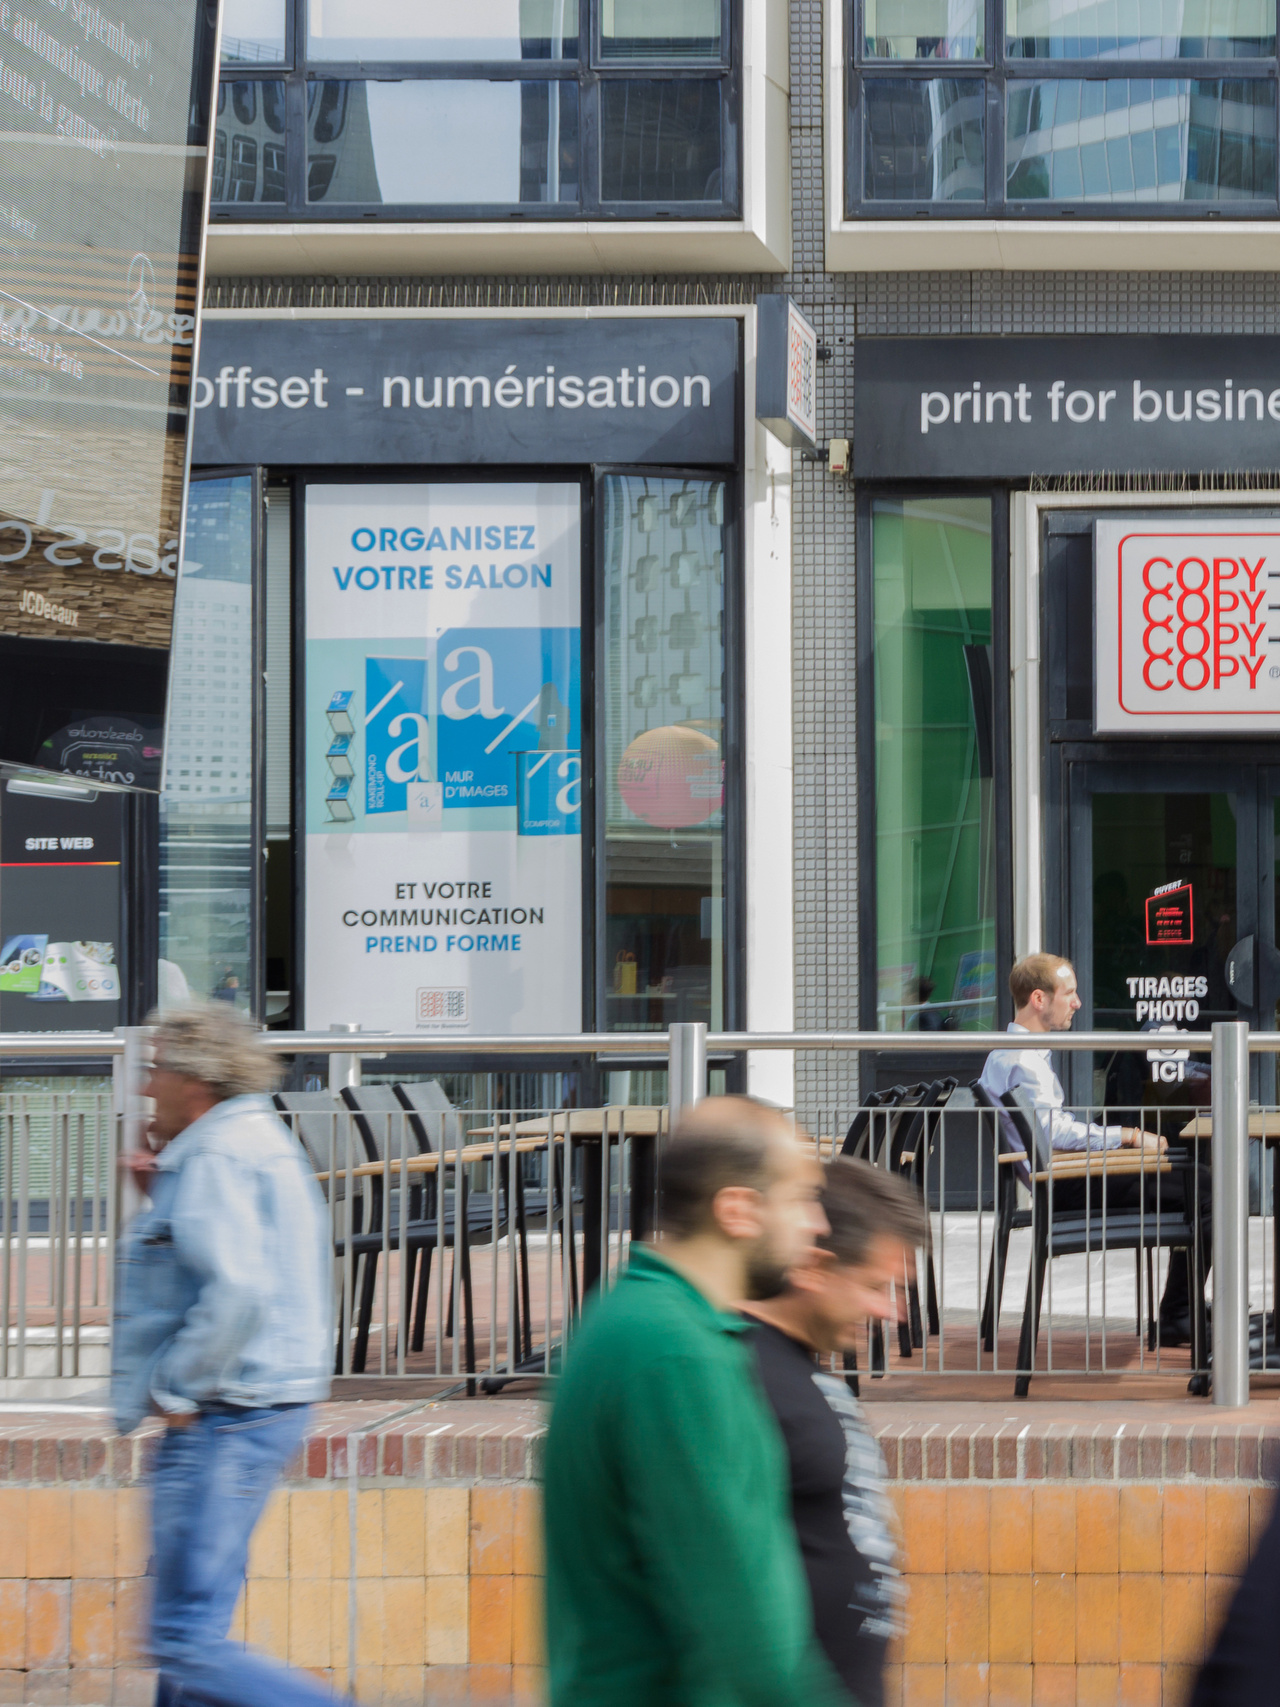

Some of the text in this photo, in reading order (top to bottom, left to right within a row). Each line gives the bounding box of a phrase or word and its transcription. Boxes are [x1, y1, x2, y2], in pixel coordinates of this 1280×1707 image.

[40, 81, 53, 123] la
[194, 366, 328, 410] offset
[383, 365, 711, 409] numérisation
[920, 381, 1032, 434] print
[1047, 380, 1117, 422] for
[351, 525, 536, 552] ORGANISEZ
[332, 564, 552, 591] VOTRE SALON
[19, 589, 79, 628] JCDecaux
[368, 754, 377, 809] KAKEMONO
[445, 770, 474, 783] MUR
[445, 785, 509, 798] D'IMAGES
[25, 837, 94, 851] SITE WEB
[395, 881, 492, 900] ET VOTRE
[342, 907, 545, 927] COMMUNICATION
[365, 934, 521, 954] PREND FORME
[1126, 976, 1208, 999] TIRAGES
[1136, 1000, 1200, 1022] PHOTO
[1152, 1061, 1185, 1083] ICI
